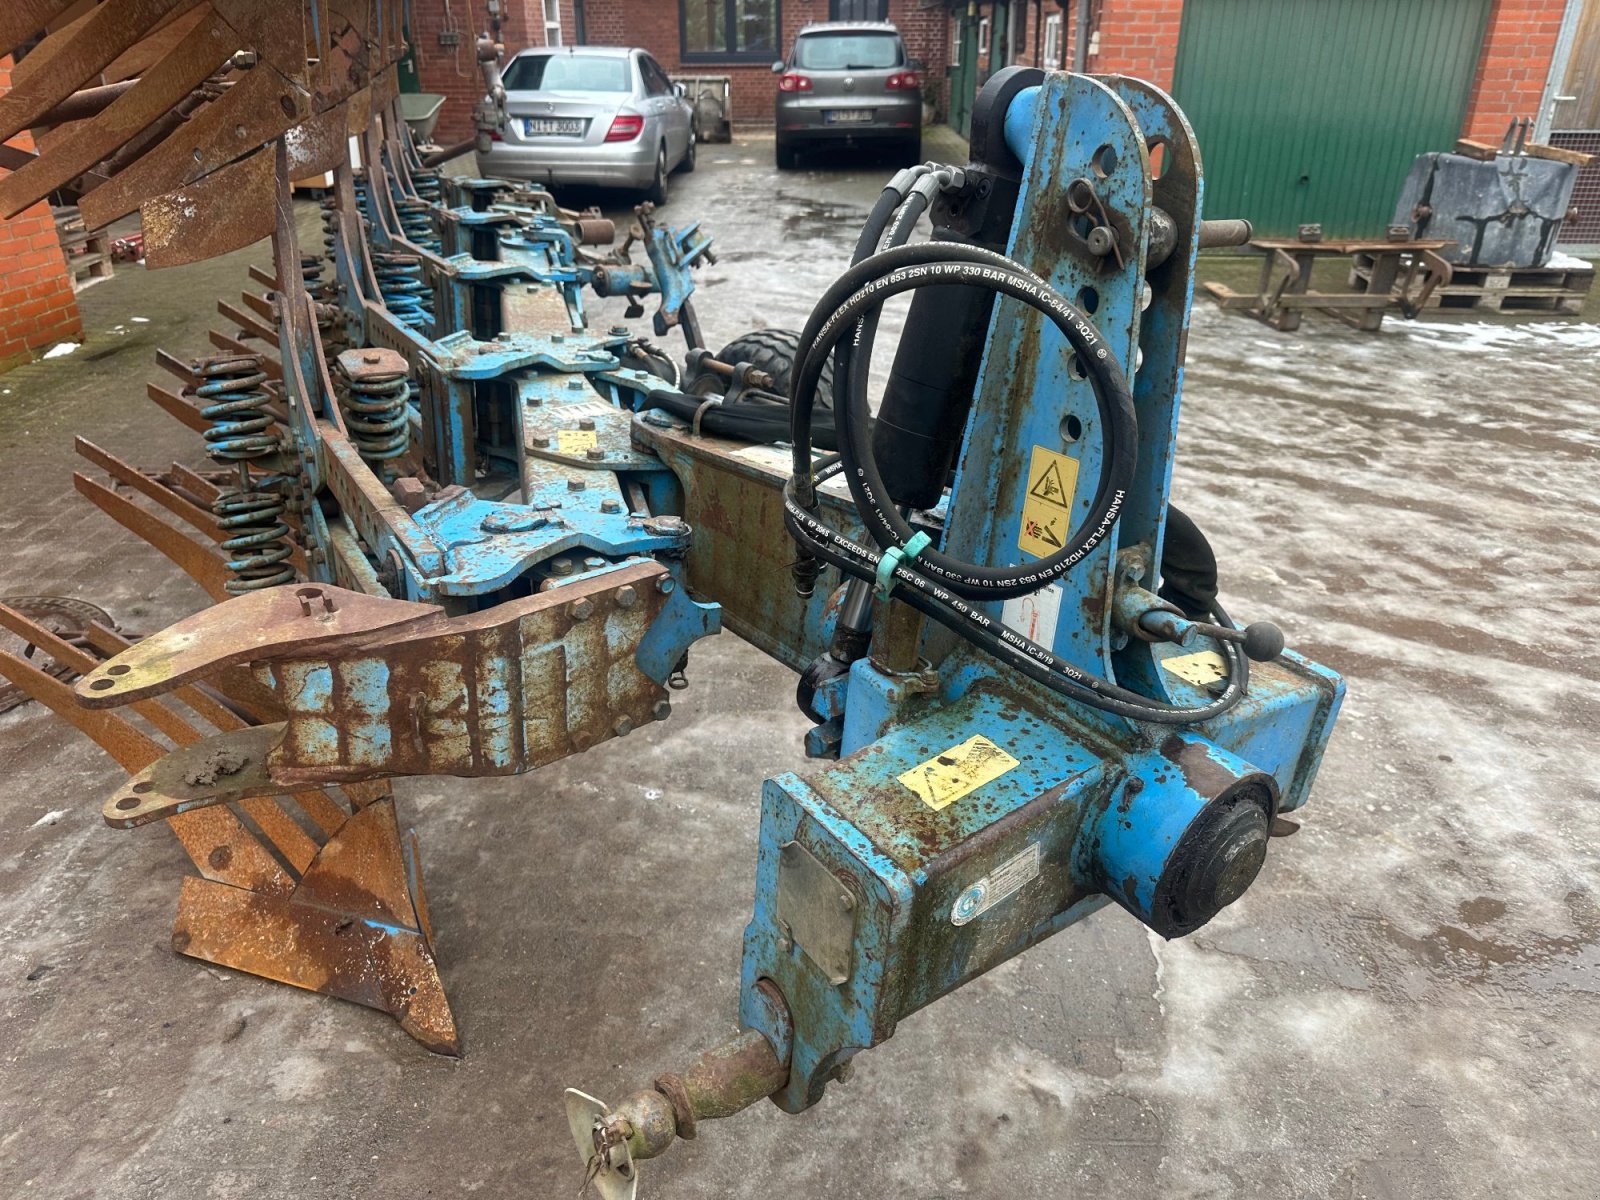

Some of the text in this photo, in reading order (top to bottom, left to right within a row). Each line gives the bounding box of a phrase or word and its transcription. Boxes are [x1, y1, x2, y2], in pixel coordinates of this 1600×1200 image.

[812, 304, 850, 349] HANSA-FLEX
[849, 284, 874, 306] HD210
[876, 278, 889, 290] EN
[890, 271, 906, 283] 853
[908, 266, 928, 278] 2SN
[930, 266, 942, 274] 10
[944, 264, 961, 274] WP
[963, 266, 981, 276] 330
[982, 269, 1006, 282] BAR
[1008, 276, 1037, 295] MSHA
[1075, 321, 1098, 345] 3Q21
[853, 314, 865, 346] HANS
[862, 482, 876, 504] 3Q21
[1082, 489, 1125, 551] HANSA-FLEX
[924, 560, 944, 574] BAR
[1054, 549, 1085, 572] HD210
[945, 571, 962, 580] 330
[964, 578, 980, 586] WP
[997, 578, 1017, 587] 2SN
[1019, 574, 1037, 585] 853
[1039, 568, 1054, 580] EN
[834, 535, 868, 558] EXCEEDS
[868, 553, 880, 564] EN
[895, 568, 914, 582] 2SC
[914, 577, 926, 588] 06
[933, 588, 949, 600] WP
[951, 600, 968, 612] 450
[970, 611, 990, 627] BAR
[1001, 630, 1026, 650] MSHA
[1026, 645, 1054, 665] IC-8/19
